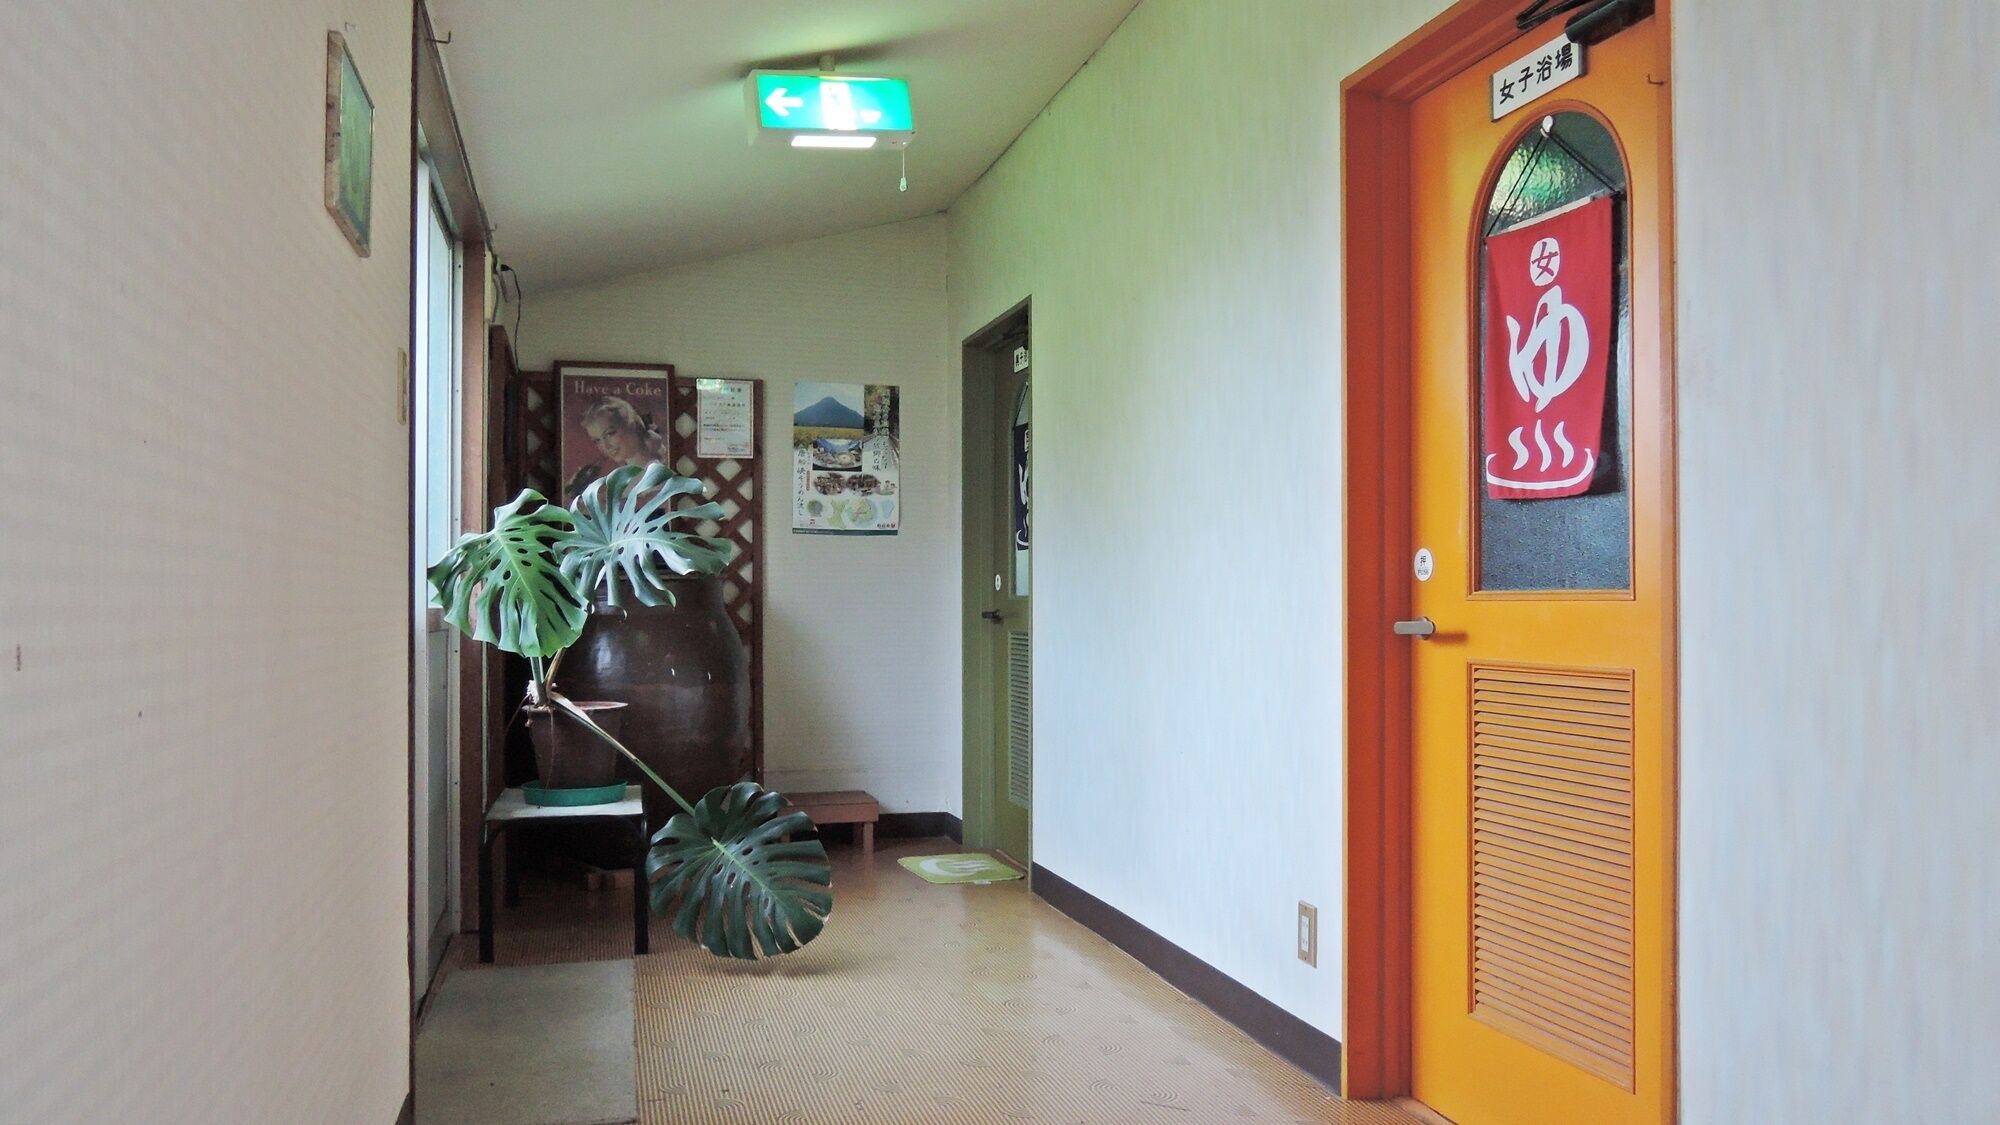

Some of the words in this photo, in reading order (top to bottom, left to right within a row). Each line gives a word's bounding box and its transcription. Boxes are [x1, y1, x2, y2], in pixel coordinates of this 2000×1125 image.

[1499, 42, 1573, 105] 女子浴場
[1530, 241, 1559, 280] 女
[1506, 284, 1590, 413] ゆ
[575, 380, 609, 395] Have
[614, 387, 621, 395] a
[626, 382, 662, 396] Coke
